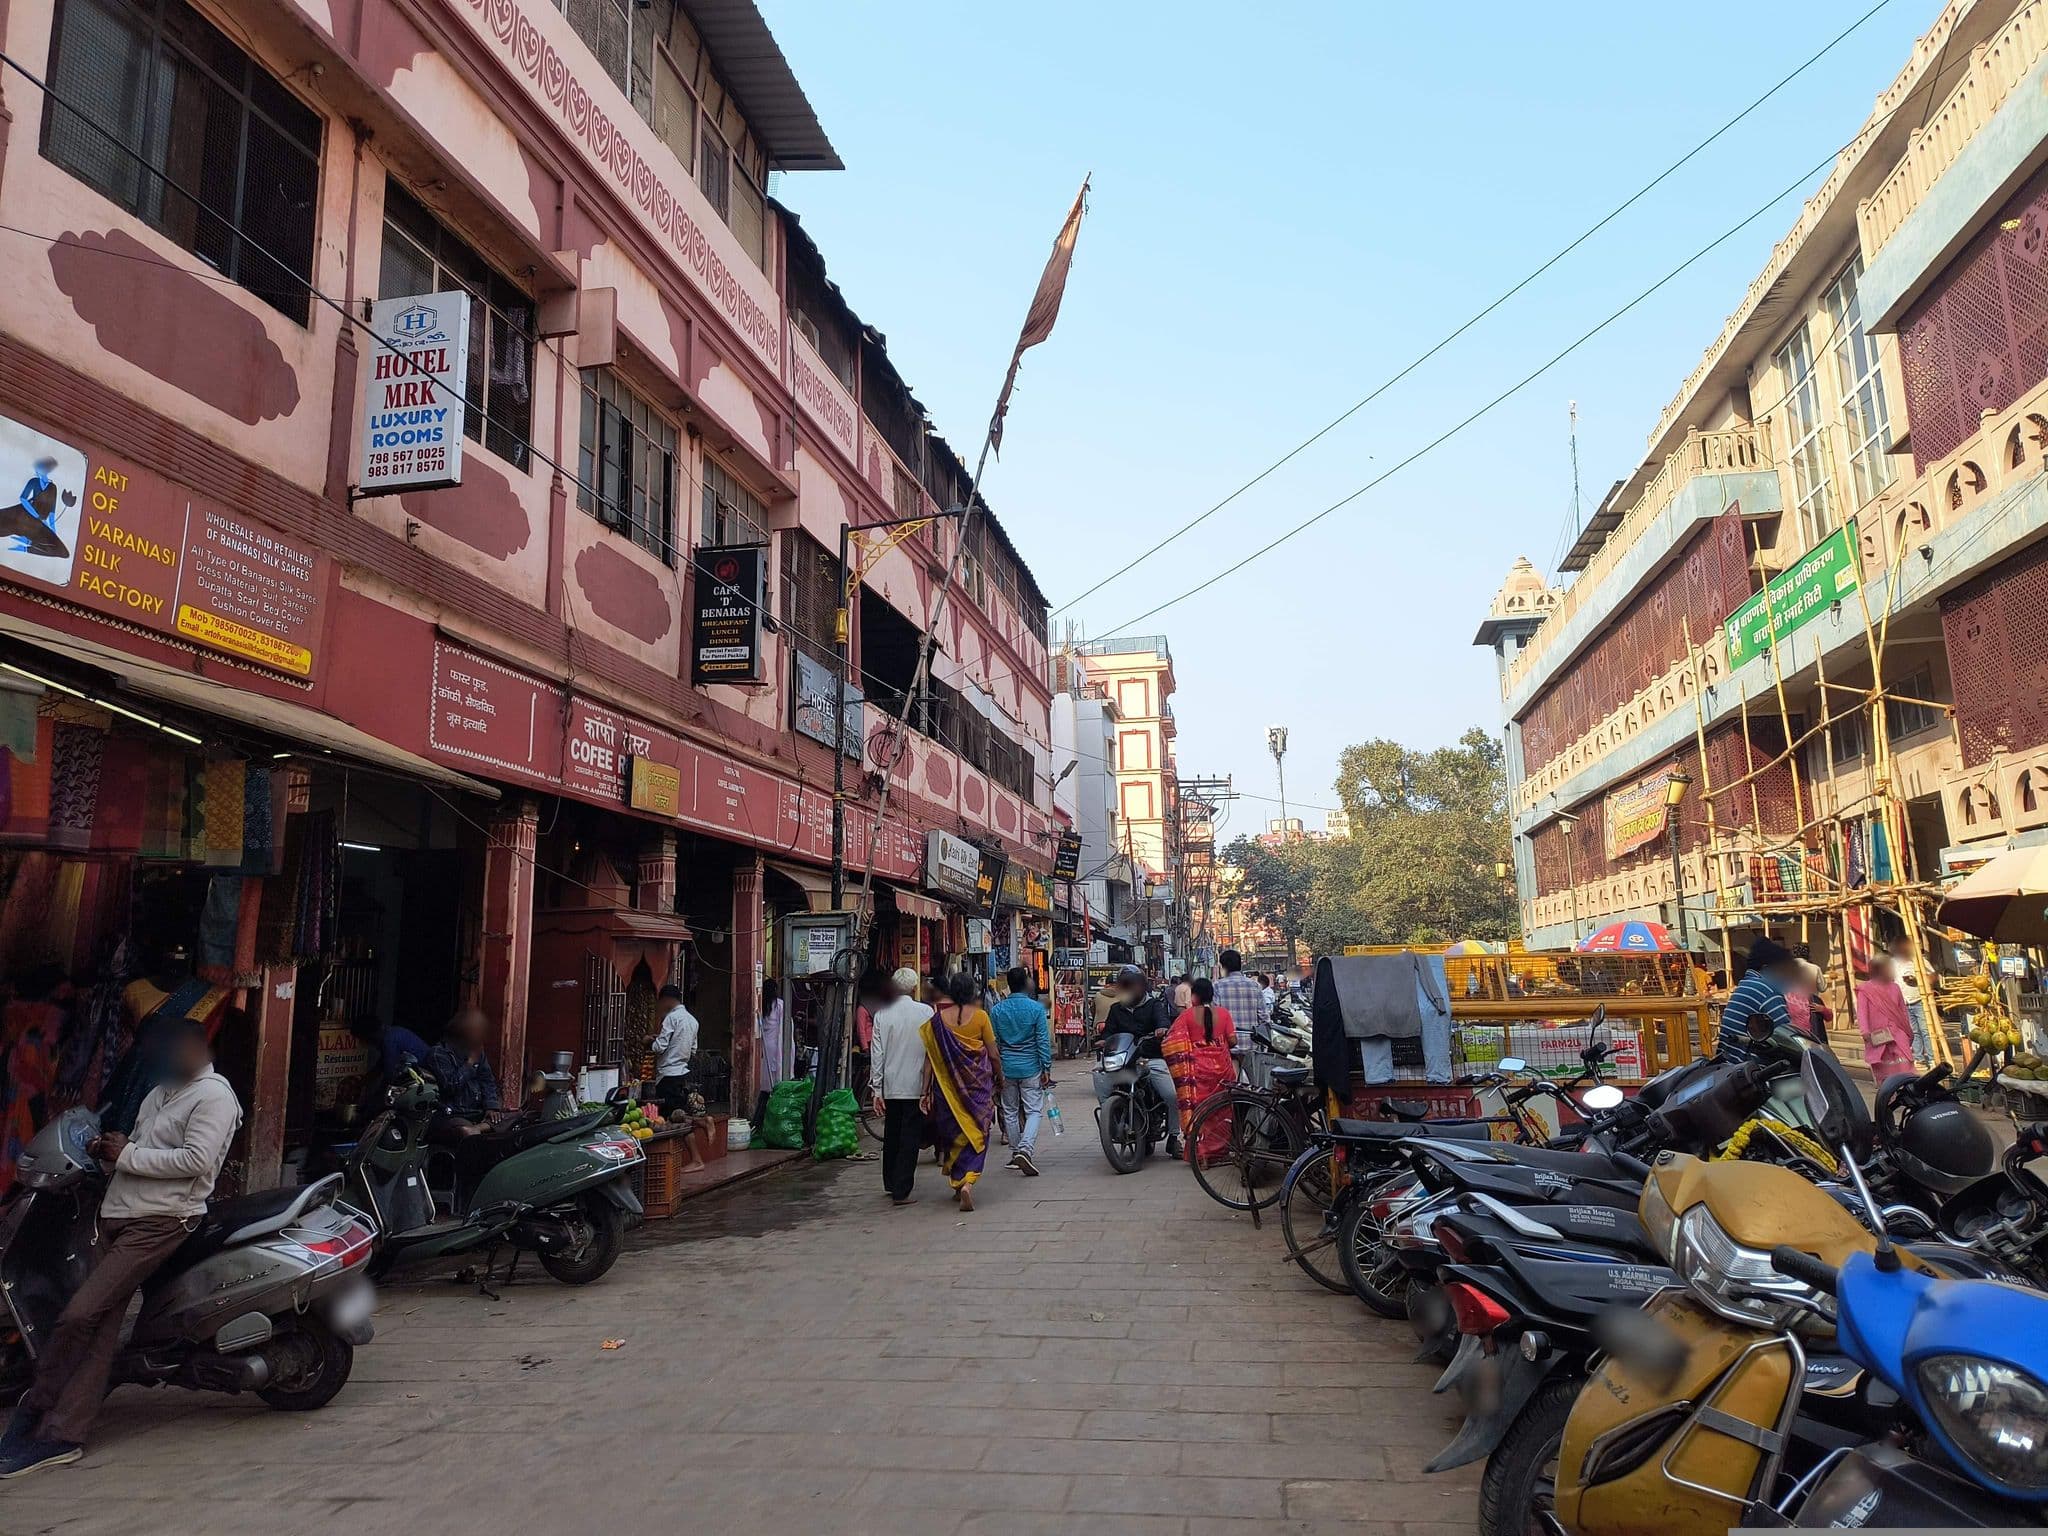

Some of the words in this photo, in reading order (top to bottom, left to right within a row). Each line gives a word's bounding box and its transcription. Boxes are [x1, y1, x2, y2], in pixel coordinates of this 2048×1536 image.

[374, 348, 451, 381] HOTEL
[383, 380, 437, 410] MRK
[370, 407, 448, 430] LUXURY
[372, 426, 444, 449] ROOMS
[369, 453, 389, 465] 798
[393, 450, 413, 462] 567
[417, 447, 445, 460] 0025
[94, 465, 129, 492] ART
[367, 465, 389, 478] 983
[391, 463, 413, 475] 817
[416, 460, 445, 473] 8570
[92, 491, 119, 514] OF
[89, 516, 176, 567] VARANASI
[205, 511, 254, 540] WHOLESALE
[256, 534, 272, 550] AND
[274, 542, 314, 569] RETAILERS
[83, 544, 122, 573] SILK
[206, 528, 219, 541] OF
[220, 534, 261, 561] BANARASI
[262, 552, 280, 569] SILK
[281, 560, 310, 582] SAREES
[191, 545, 204, 557] All
[206, 549, 228, 567] Type
[230, 560, 242, 571] Of
[242, 565, 278, 588] Banarasi
[279, 581, 294, 595] Silk
[195, 560, 221, 579] Dress
[1795, 546, 1834, 589] प्राधिकरण
[79, 571, 164, 615] FACTORY
[1783, 596, 1804, 624] स्मार्ट
[1803, 583, 1823, 610] सिटी
[189, 608, 209, 625] Mob
[211, 596, 248, 618] Cushion
[249, 610, 274, 627] Cover
[263, 602, 279, 617] Bed
[701, 607, 751, 618] BENARAS
[180, 618, 200, 633] Email
[702, 619, 749, 627] BREAKFAST
[449, 669, 471, 685] फास्ट
[810, 692, 834, 718] HOTEL
[462, 717, 487, 734] इत्यादि
[583, 713, 617, 747] कॉफी
[570, 738, 613, 771] COFEE
[1592, 1208, 1615, 1218] Honda
[1622, 1270, 1652, 1281] AGARWAL
[2001, 1274, 2030, 1286] Hero
